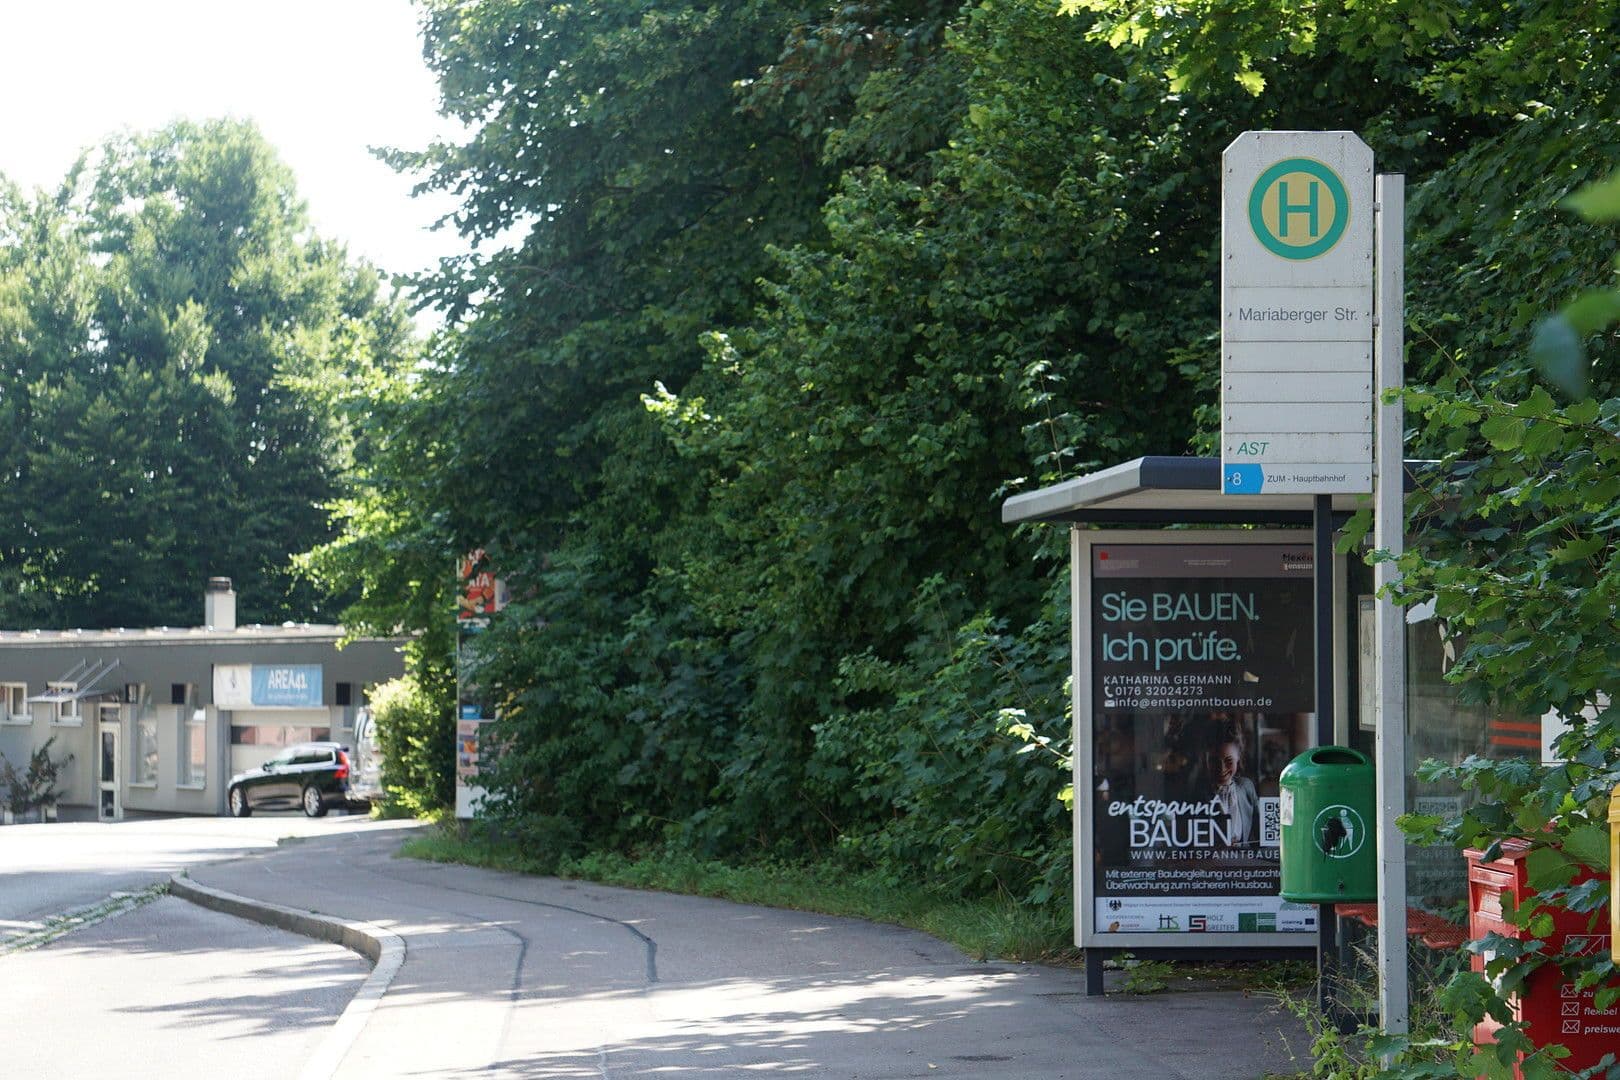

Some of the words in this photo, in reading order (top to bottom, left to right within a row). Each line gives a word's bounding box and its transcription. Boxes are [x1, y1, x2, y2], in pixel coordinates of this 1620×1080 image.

[1279, 181, 1318, 237] H
[1239, 307, 1328, 325] Mariaberger
[1334, 307, 1358, 321] Str.
[1236, 442, 1269, 455] AST
[1232, 472, 1242, 486] 8
[1267, 474, 1286, 483] ZUM
[1293, 473, 1346, 485] Hauptbahnhof
[1102, 591, 1147, 622] Sie
[1153, 592, 1260, 621] BAUEN.
[1103, 631, 1149, 662] Ich
[1155, 630, 1242, 671] prüfe.
[1104, 675, 1170, 684] KATHARINA
[1174, 675, 1232, 684] GERMANN
[1115, 686, 1141, 696] 0176
[1146, 686, 1203, 696] 32024273
[1115, 697, 1272, 709] info@entspanntbauen.de
[1108, 795, 1226, 824] entspannt
[1130, 818, 1231, 848] BAUEN
[1105, 869, 1120, 879] Mit
[1121, 870, 1157, 880] externer
[1157, 868, 1223, 882] Baubegleitung
[1224, 869, 1239, 879] und
[1105, 880, 1169, 892] Überwachung
[1191, 880, 1229, 890] sicheren
[1230, 880, 1274, 890] Hausbau.
